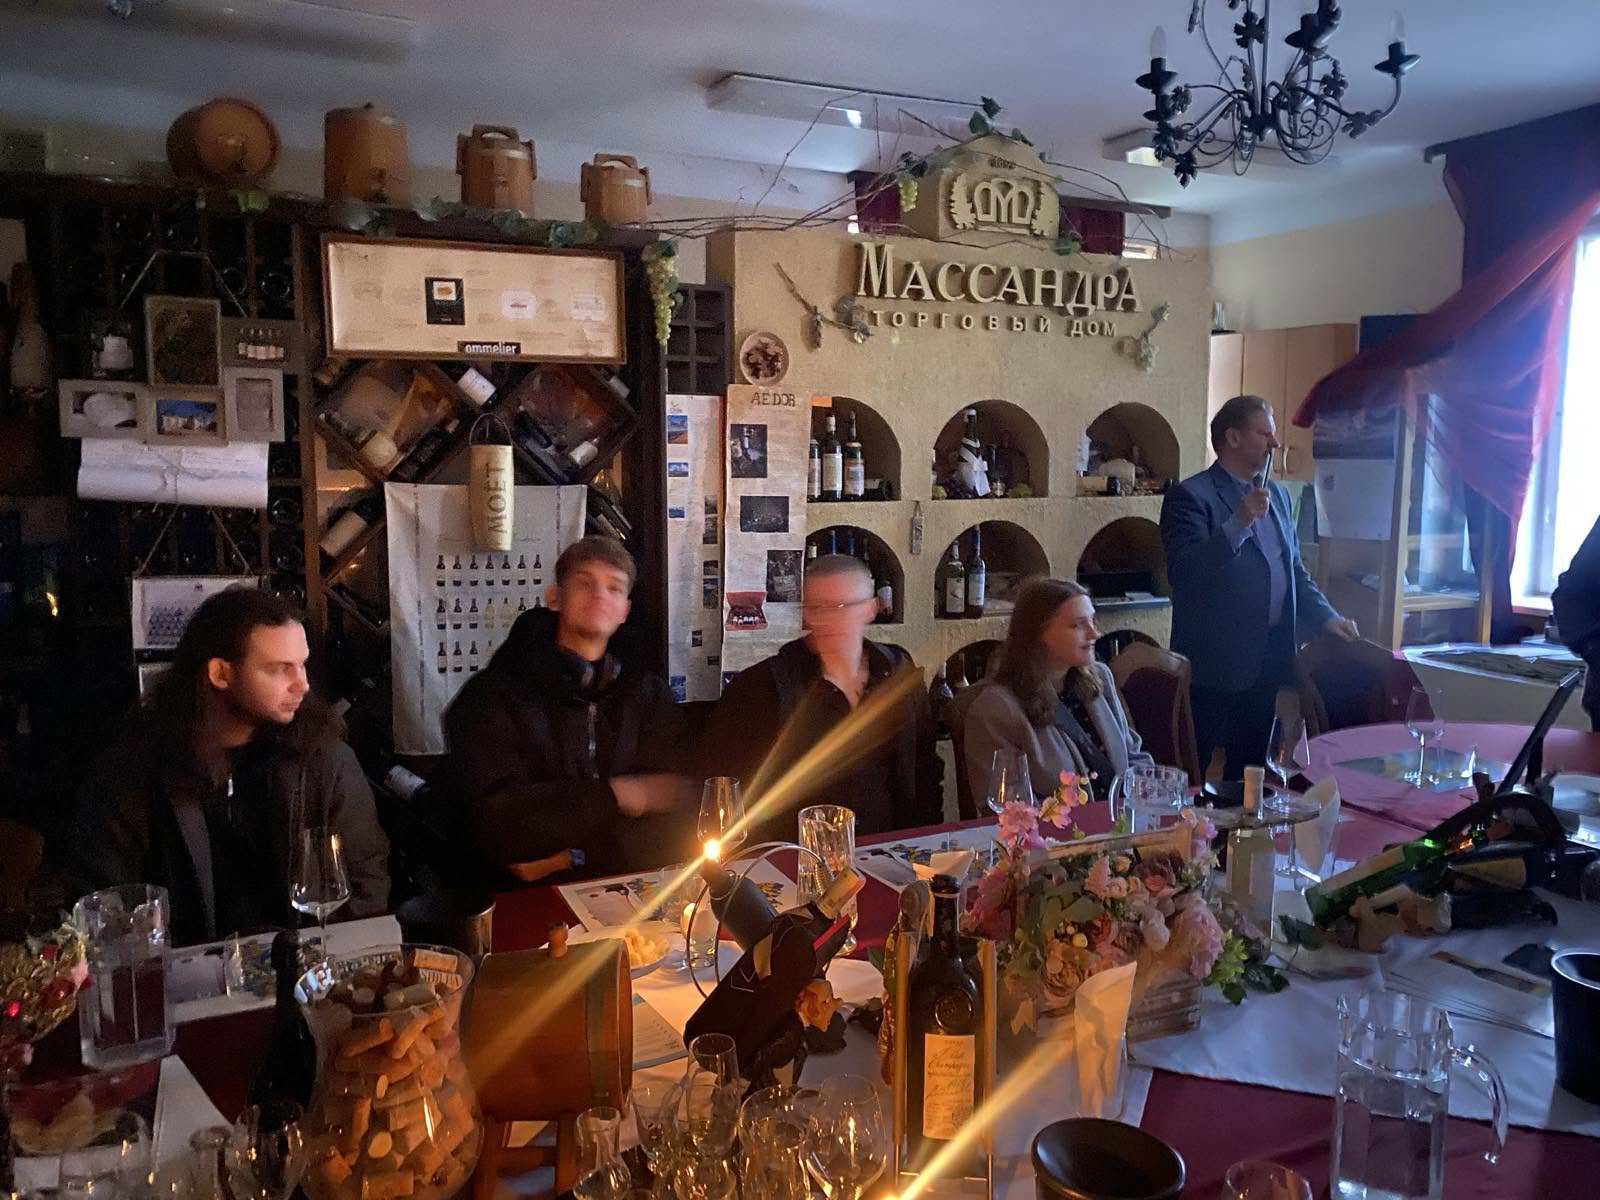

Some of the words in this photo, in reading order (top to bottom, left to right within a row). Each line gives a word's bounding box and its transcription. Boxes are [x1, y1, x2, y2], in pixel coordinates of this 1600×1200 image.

[857, 241, 1143, 316] МАССАНДРА
[873, 310, 1051, 333] ТОРГОВЫЙ
[1070, 319, 1117, 338] ДОМ
